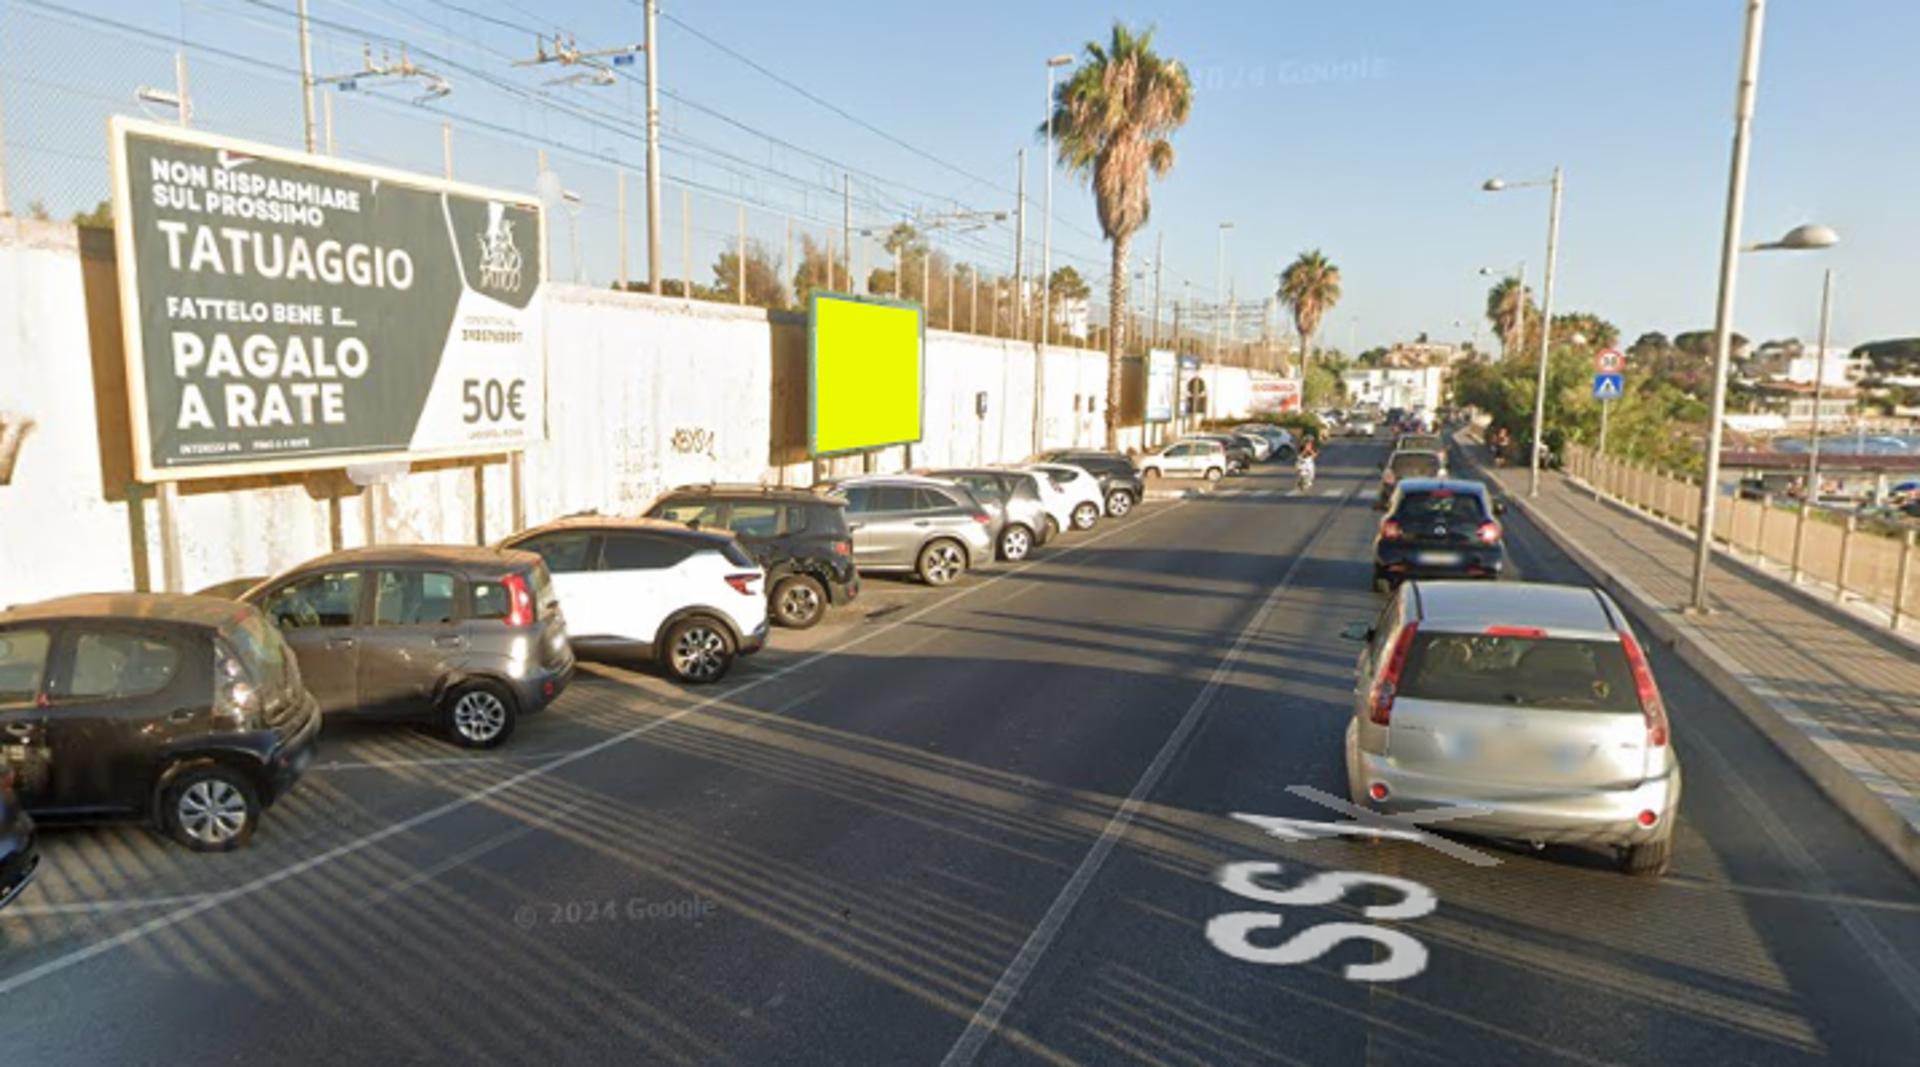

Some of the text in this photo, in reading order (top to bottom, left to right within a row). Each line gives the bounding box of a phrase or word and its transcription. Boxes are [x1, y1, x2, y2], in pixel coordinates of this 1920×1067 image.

[151, 157, 361, 213] NON RISPARMIARE
[152, 184, 324, 228] SUL PROSSIMO
[157, 219, 414, 290] TATUAGGIO
[166, 296, 269, 323] FATTELO
[272, 303, 323, 325] BENE
[171, 331, 369, 379] PAGALO
[176, 382, 346, 430] A RATE
[462, 377, 527, 424] 50€
